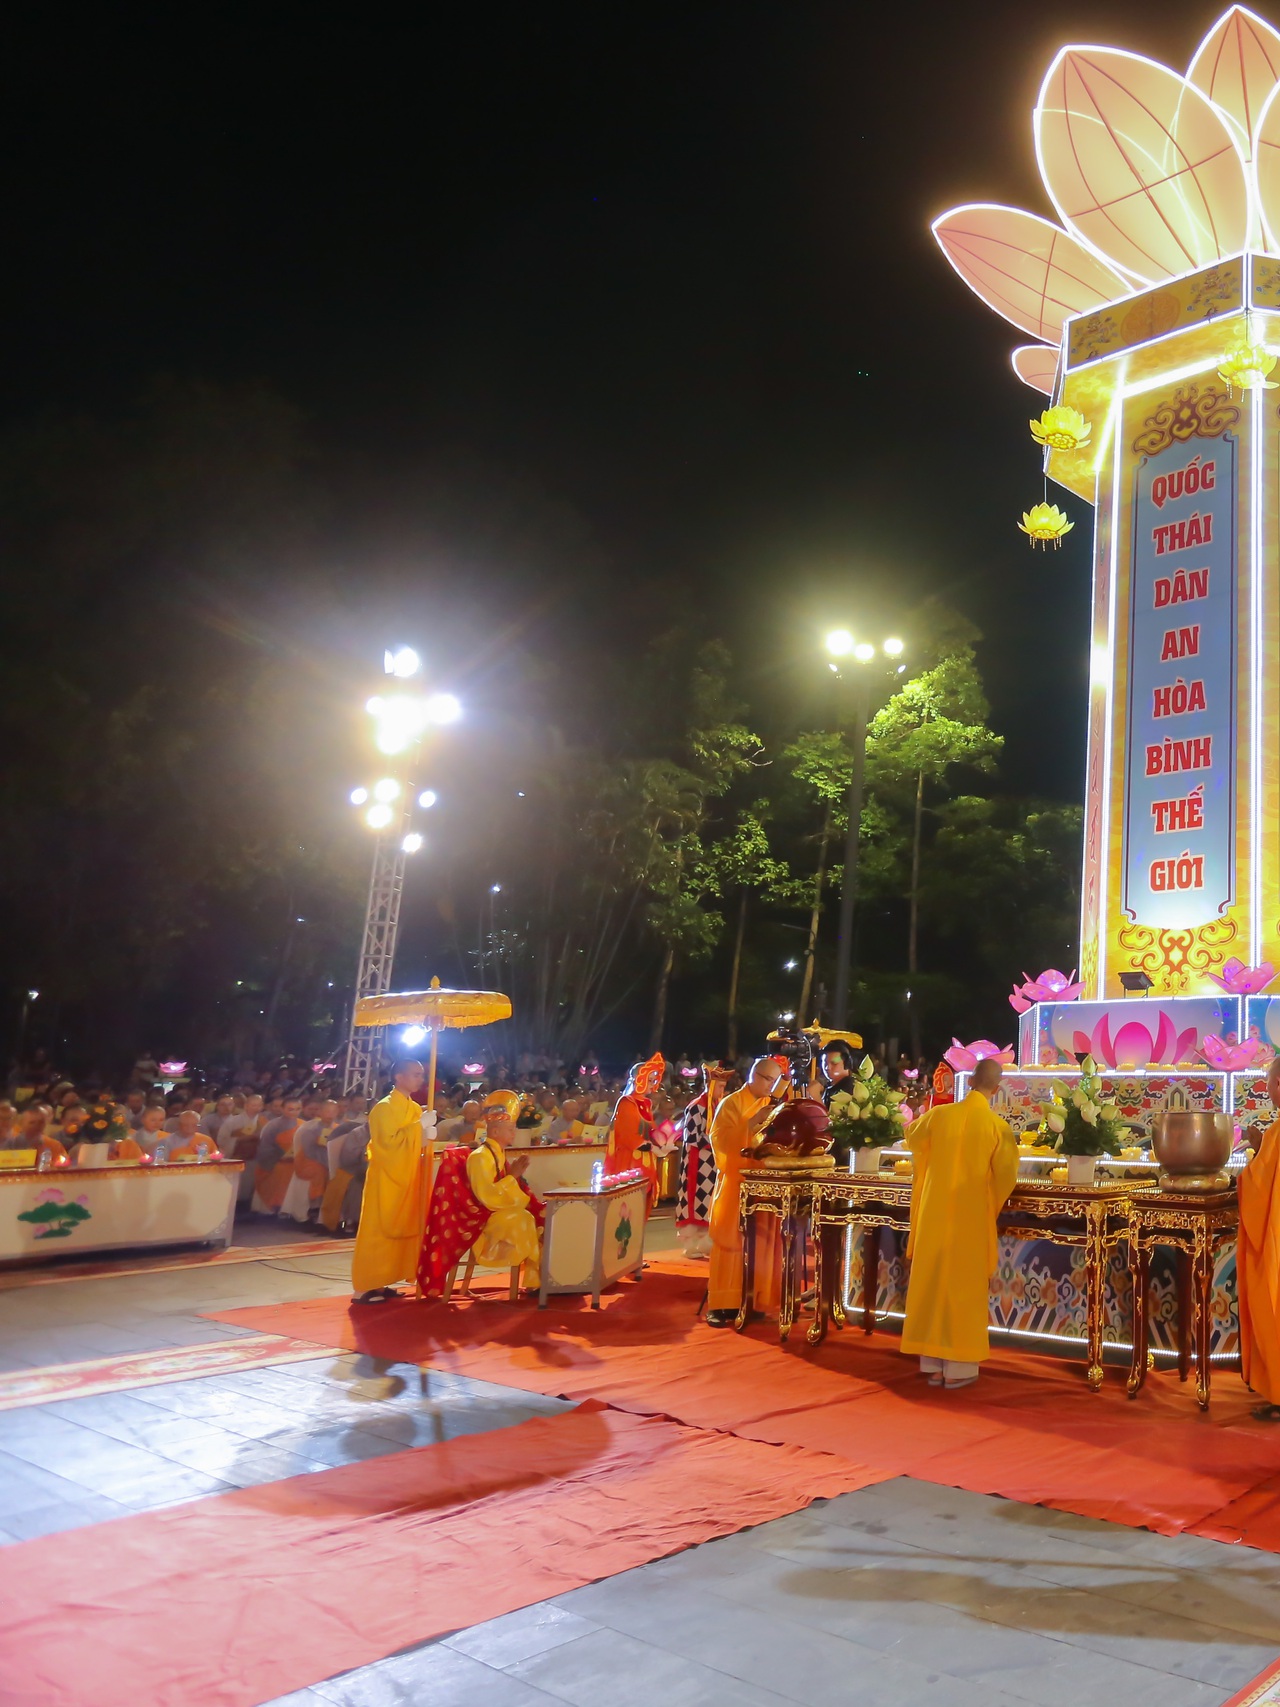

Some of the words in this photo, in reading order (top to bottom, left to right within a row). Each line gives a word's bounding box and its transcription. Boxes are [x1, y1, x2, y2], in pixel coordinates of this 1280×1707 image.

[1151, 455, 1216, 508] QUỐC
[1152, 512, 1213, 556] THÁI
[1153, 568, 1210, 609] DÂN
[1160, 624, 1200, 662] AN
[1153, 678, 1207, 719] HÒA
[1145, 736, 1212, 777] BÌNH
[1151, 784, 1204, 833] THẾ
[1149, 850, 1204, 892] GIỚI
